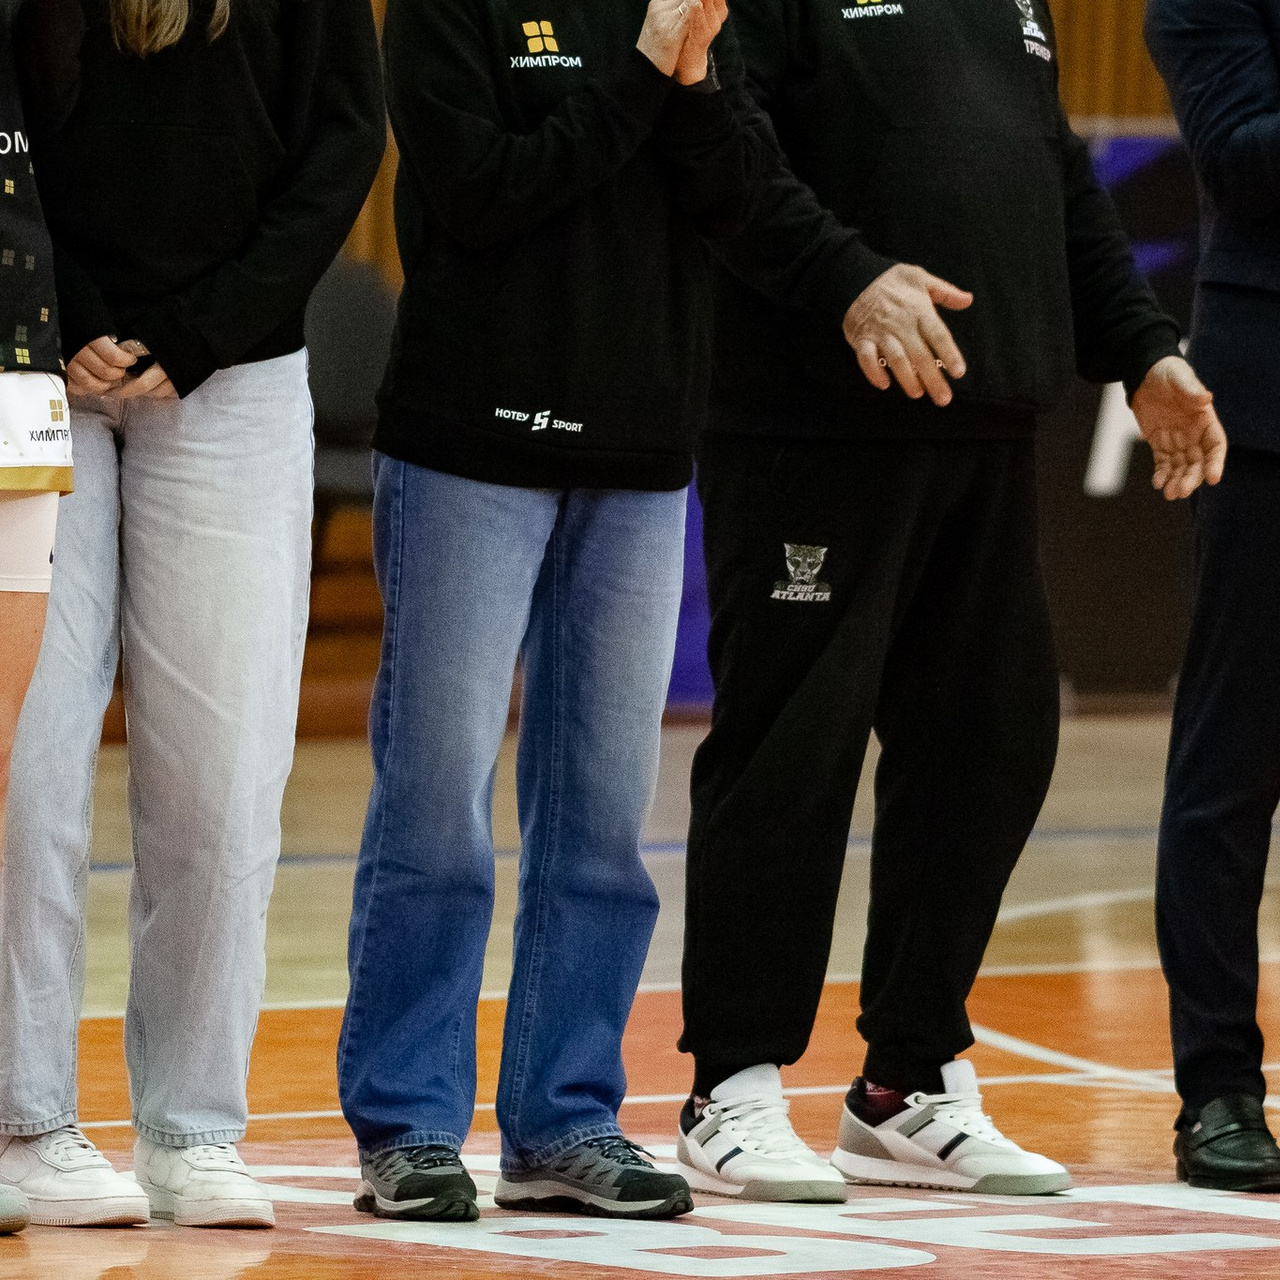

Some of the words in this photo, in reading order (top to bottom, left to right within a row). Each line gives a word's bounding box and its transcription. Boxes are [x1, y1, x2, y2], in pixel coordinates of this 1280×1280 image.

[841, 3, 904, 19] ХИМПРОМ
[509, 55, 582, 69] ХИМПРОМ
[552, 419, 583, 432] SPORT
[770, 589, 831, 601] ATLANTA
